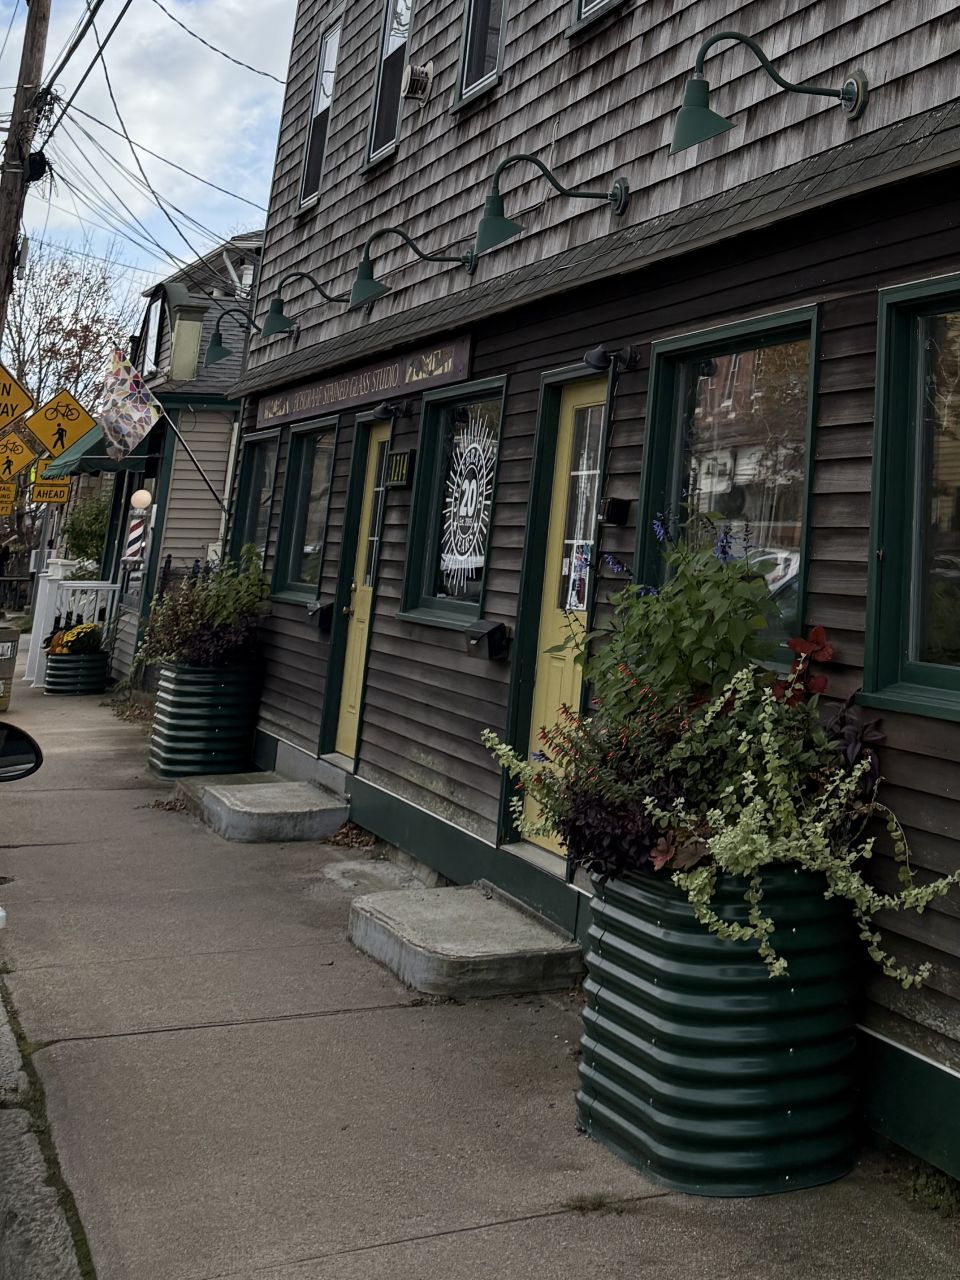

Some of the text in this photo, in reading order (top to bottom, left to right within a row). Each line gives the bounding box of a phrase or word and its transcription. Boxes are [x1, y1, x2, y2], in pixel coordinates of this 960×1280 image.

[322, 378, 349, 405] STAINED
[349, 372, 370, 398] GLASS
[371, 363, 399, 392] STUDIO
[0, 403, 19, 417] AY
[36, 489, 66, 499] AHEAD
[459, 479, 477, 517] 20
[455, 529, 474, 553] YEARS
